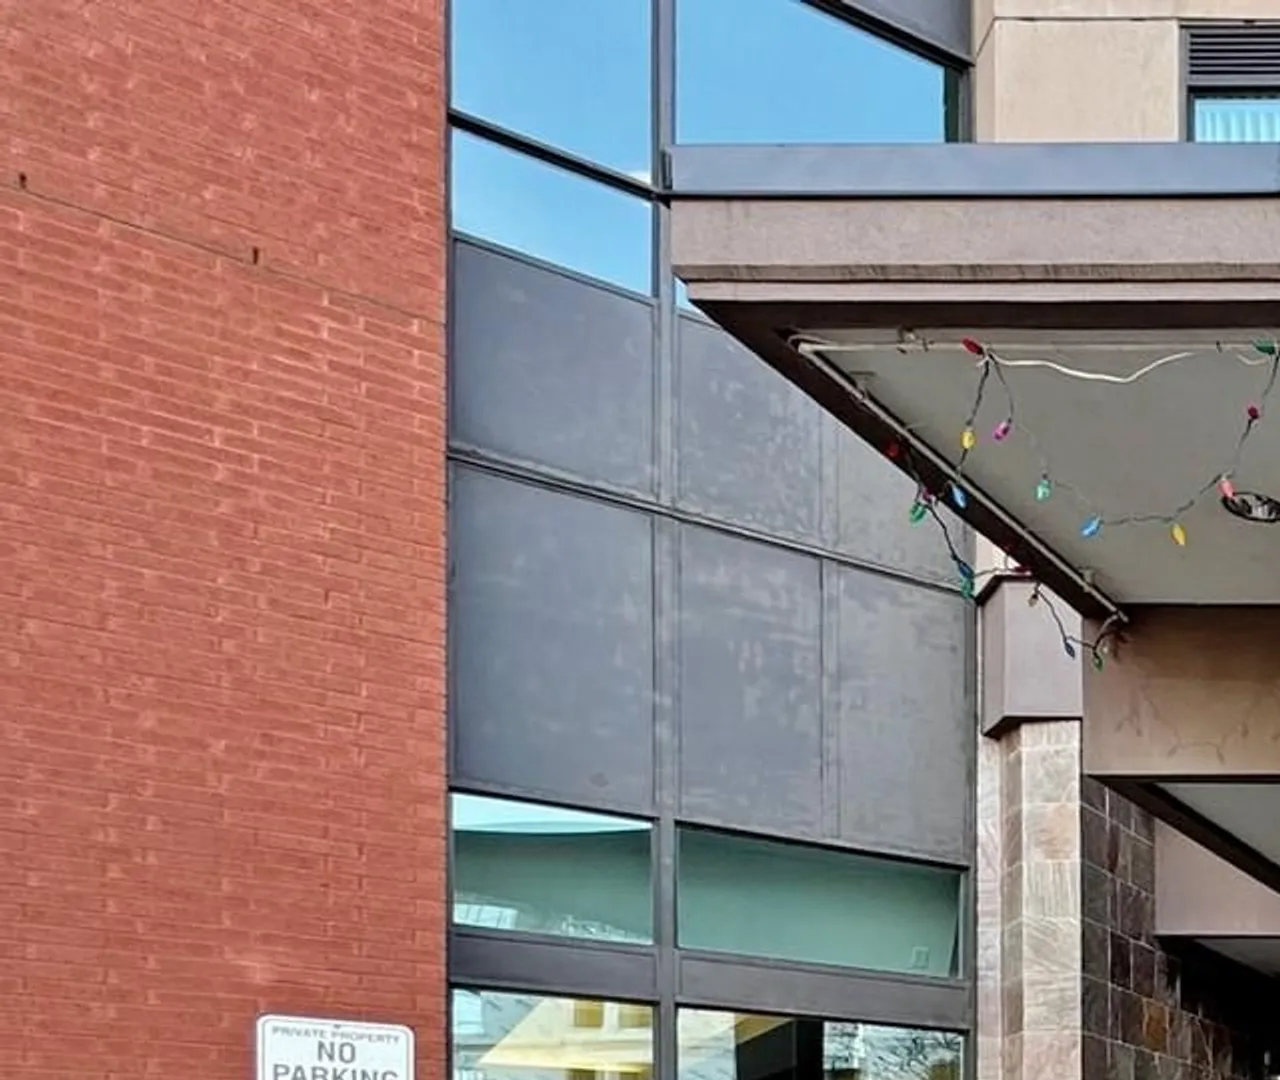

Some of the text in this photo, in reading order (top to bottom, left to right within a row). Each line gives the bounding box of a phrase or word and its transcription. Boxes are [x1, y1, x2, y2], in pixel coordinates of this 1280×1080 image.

[272, 1025, 400, 1044] PRIVATE PROPERTY
[317, 1040, 356, 1064] NO
